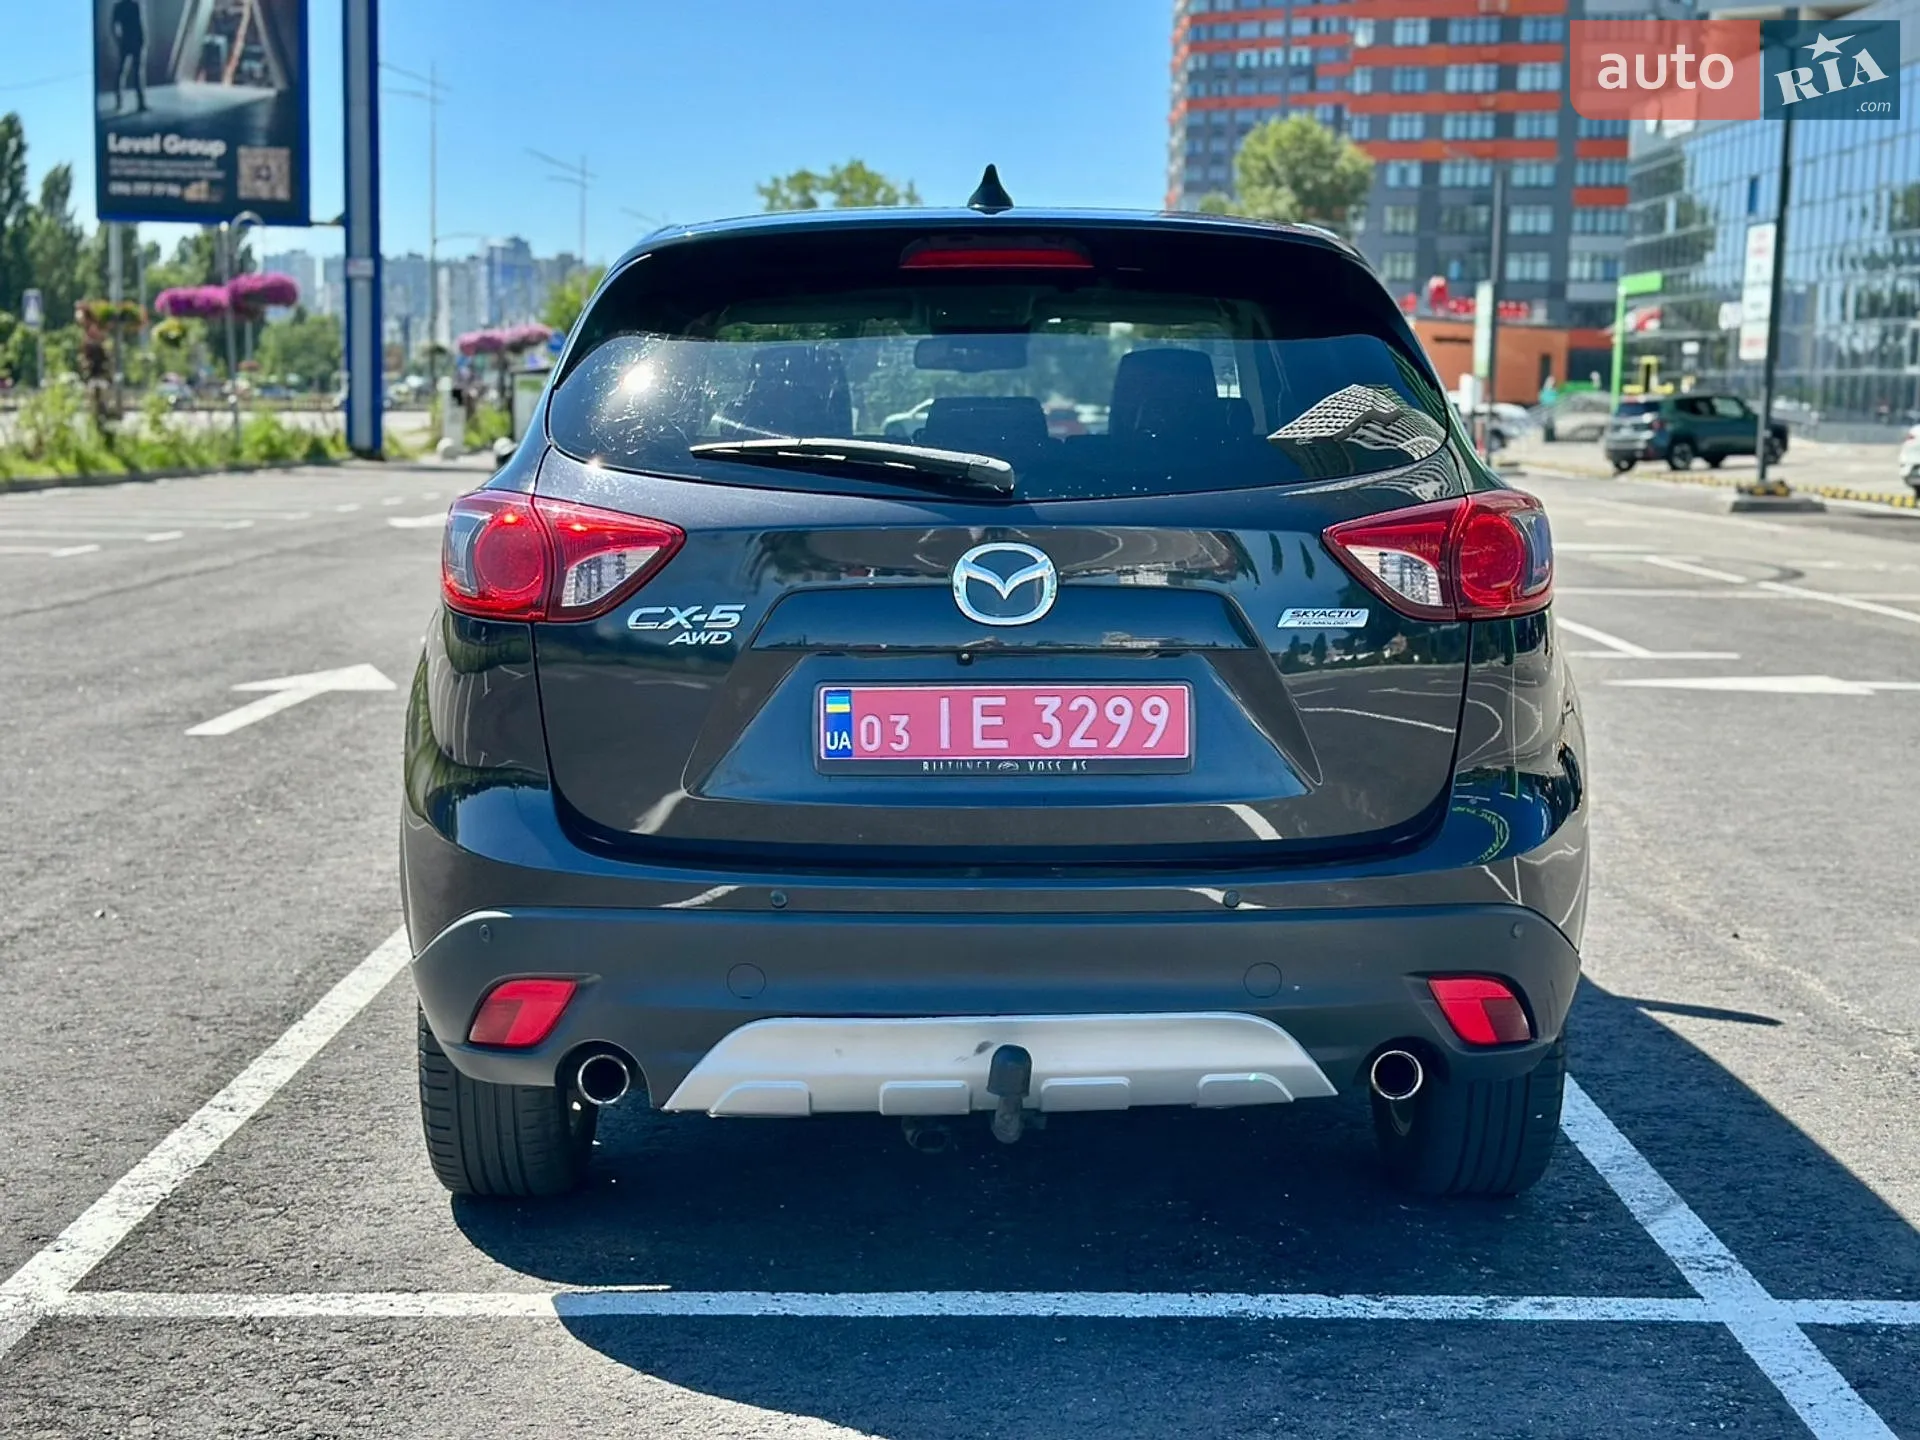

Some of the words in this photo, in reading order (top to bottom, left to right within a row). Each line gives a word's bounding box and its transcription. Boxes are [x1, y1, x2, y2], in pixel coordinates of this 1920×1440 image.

[107, 132, 162, 154] Level
[163, 133, 228, 159] Group
[627, 604, 746, 630] CX-5
[1291, 610, 1360, 618] SKYACTIV
[668, 631, 733, 645] AWD
[859, 714, 911, 752] 03
[939, 696, 1009, 750] IE
[1032, 695, 1171, 749] 3299
[826, 730, 852, 750] UA
